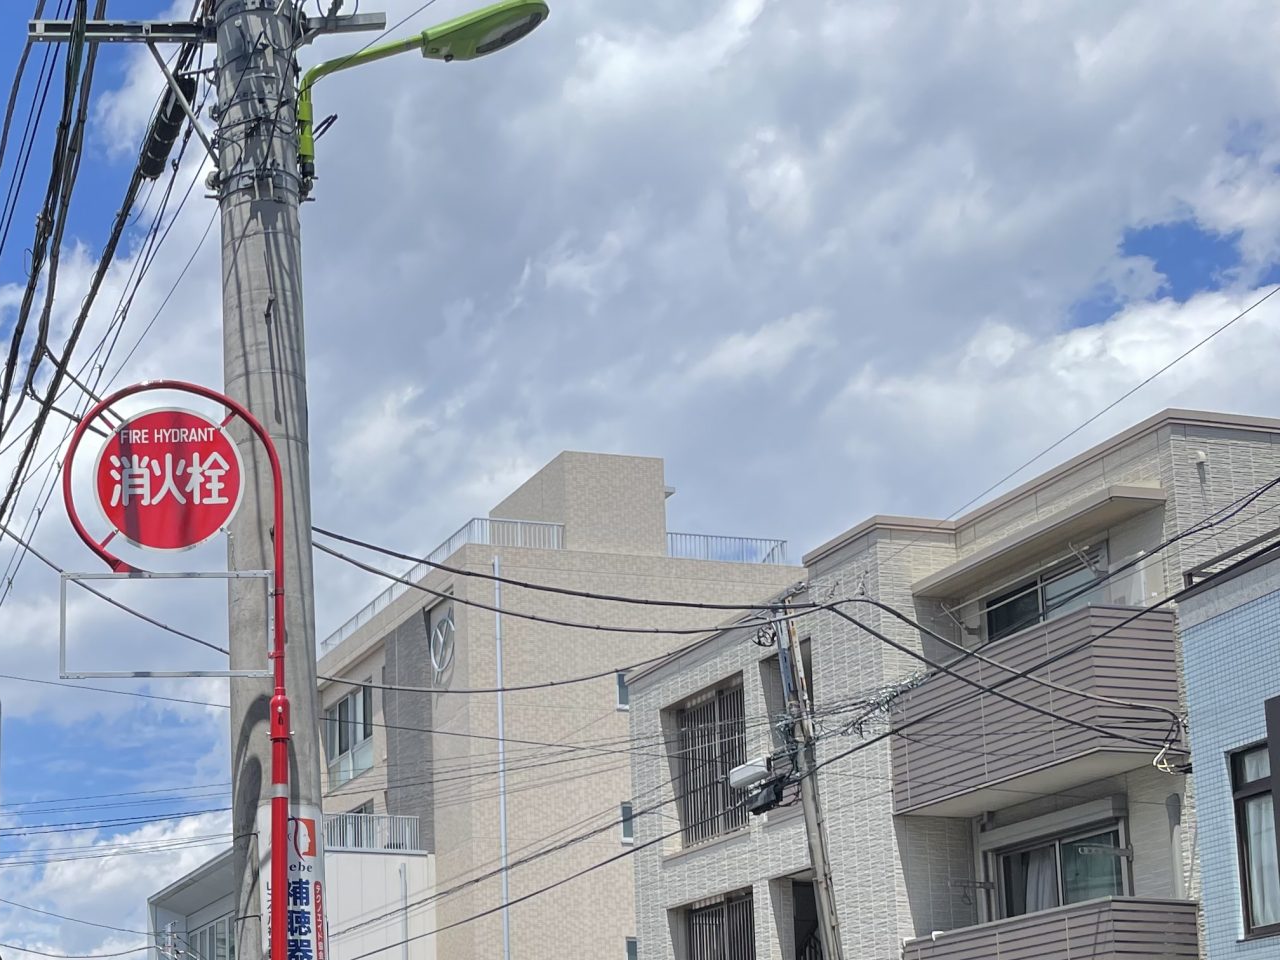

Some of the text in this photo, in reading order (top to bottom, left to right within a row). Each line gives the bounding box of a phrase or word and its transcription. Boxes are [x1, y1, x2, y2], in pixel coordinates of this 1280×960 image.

[120, 427, 215, 444] FIRE HYDRANT
[109, 451, 230, 507] 消火栓
[289, 861, 313, 872] ebe
